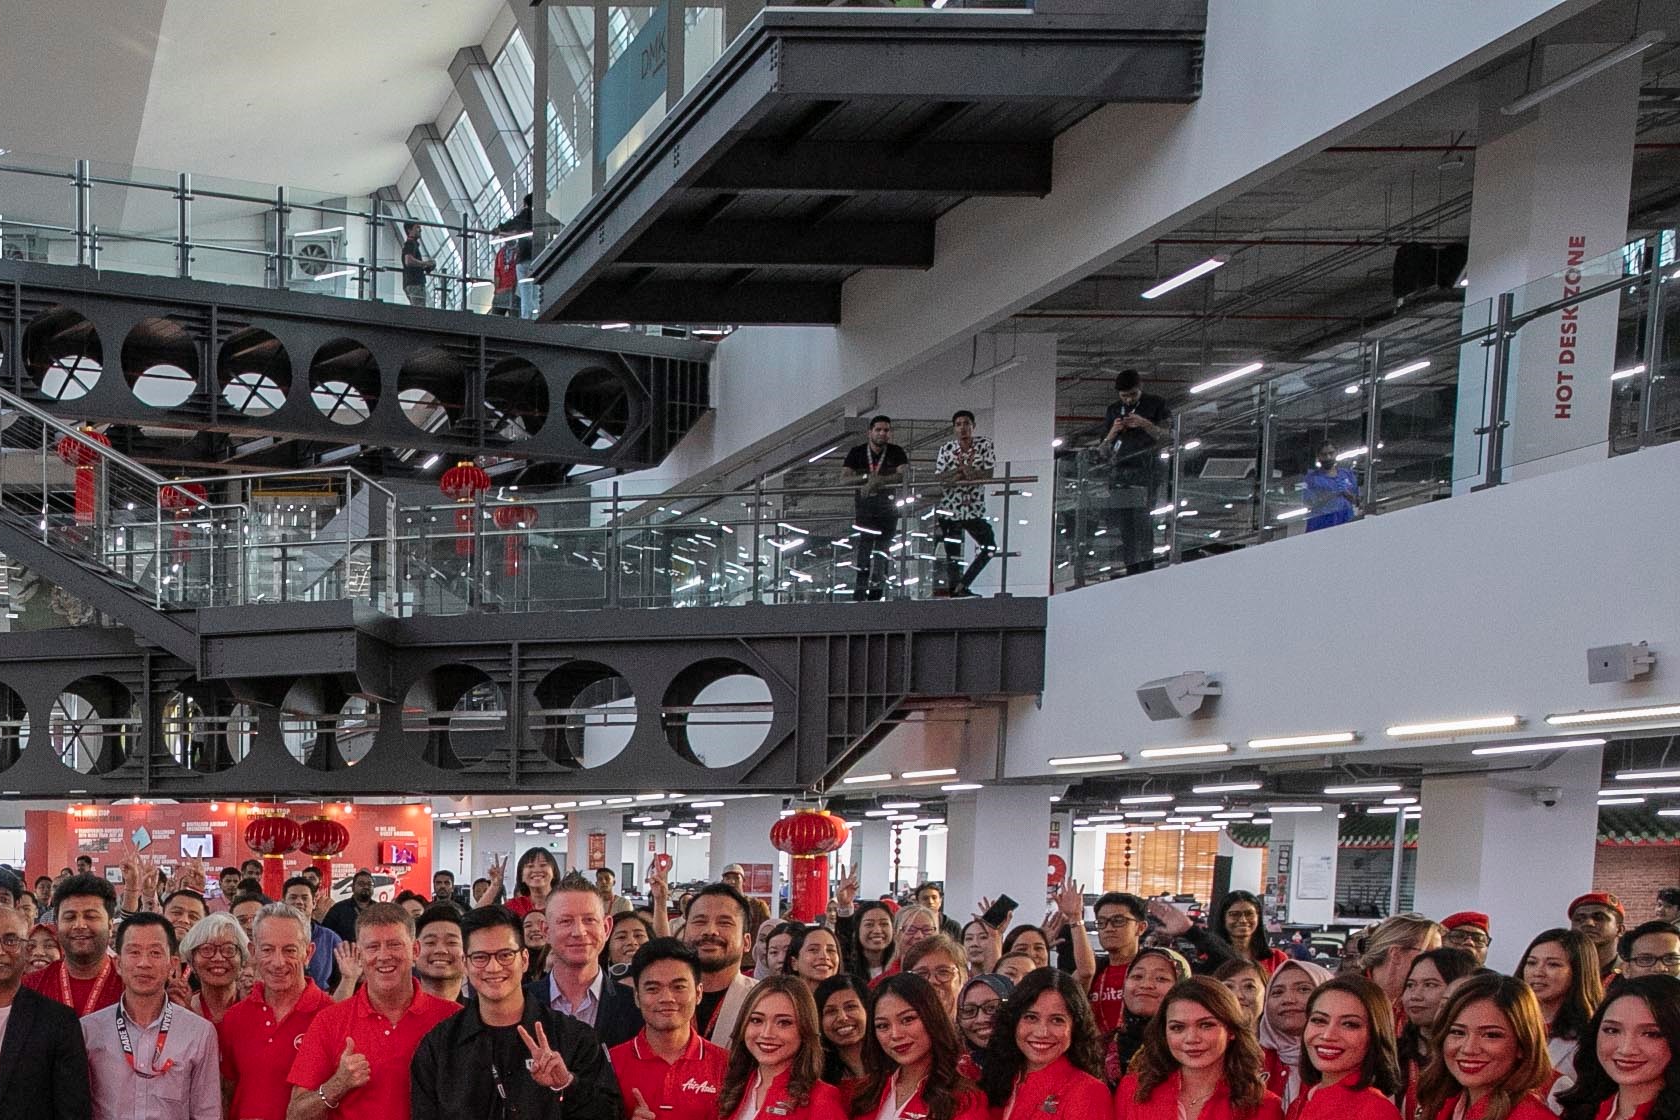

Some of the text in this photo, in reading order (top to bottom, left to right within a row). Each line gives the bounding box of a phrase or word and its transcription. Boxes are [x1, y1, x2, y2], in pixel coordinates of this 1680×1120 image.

[1555, 236, 1586, 419] HOT DESK ZONE
[117, 1018, 132, 1052] DARE TO
[682, 1078, 717, 1094] AirAsia
